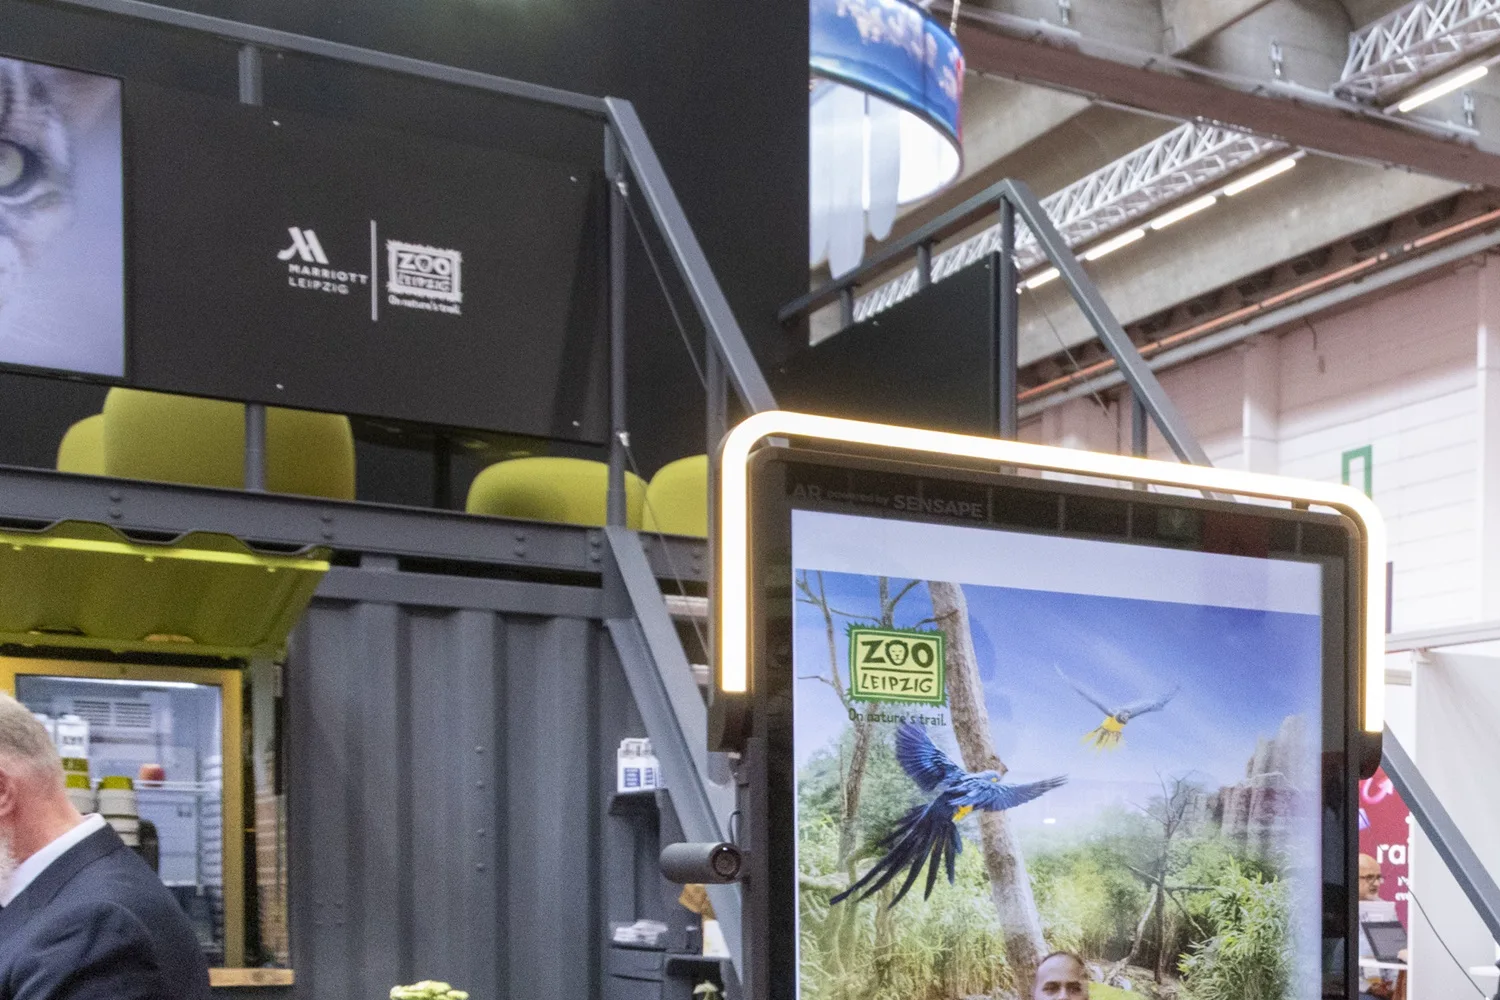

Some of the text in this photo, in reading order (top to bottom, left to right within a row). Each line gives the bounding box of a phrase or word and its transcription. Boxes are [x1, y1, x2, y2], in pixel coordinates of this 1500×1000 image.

[287, 263, 369, 285] MARRIOTT
[397, 251, 452, 276] ZOO
[287, 276, 349, 296] LEIPZIG
[398, 272, 451, 293] LEIPZIG
[793, 483, 822, 500] AR
[893, 493, 983, 519] SENSAPE
[860, 639, 935, 669] ZOO
[860, 673, 935, 694] LEIPZIG
[848, 707, 947, 727] On nature's trail.
